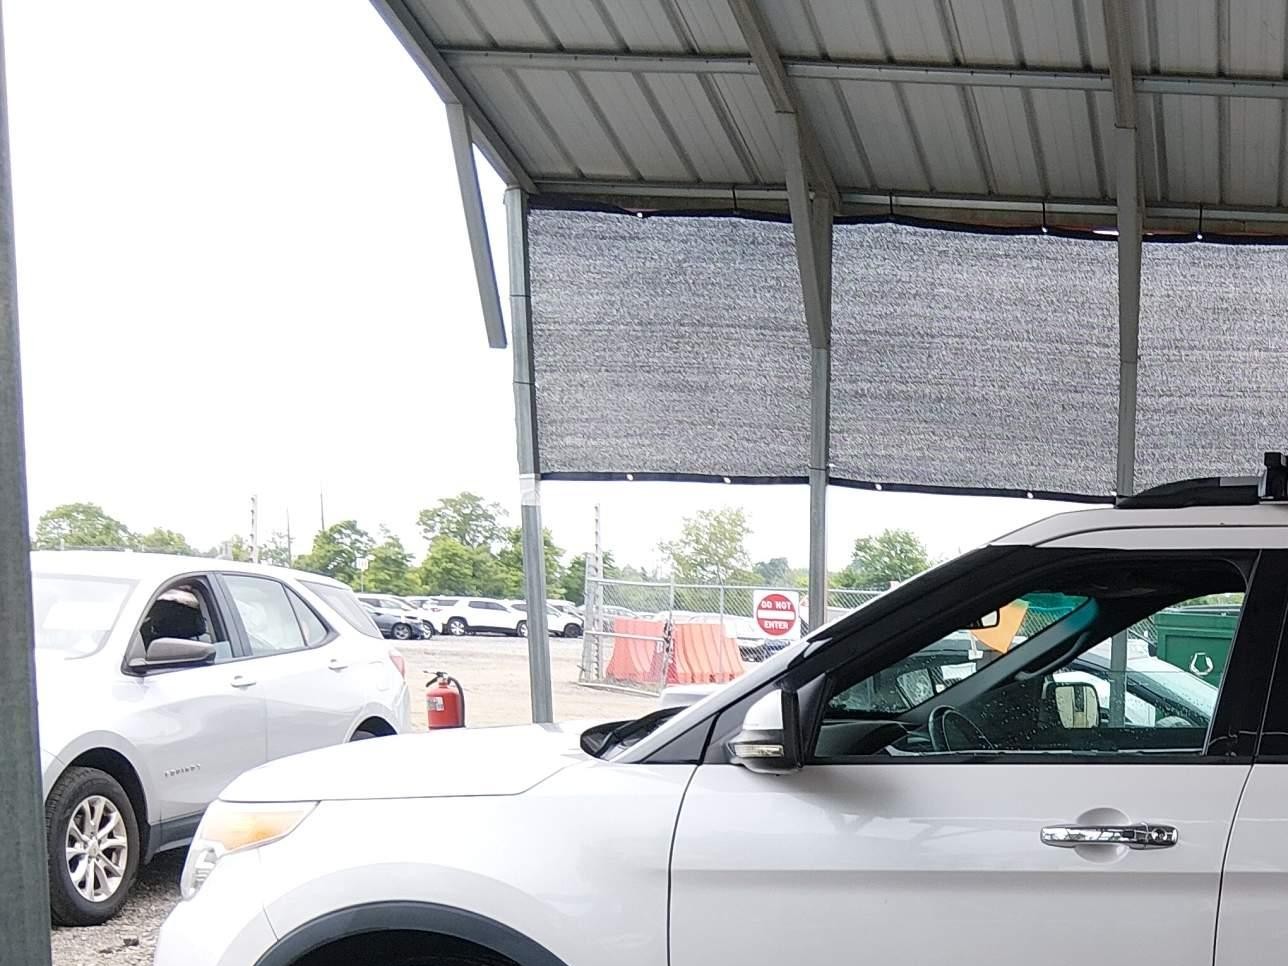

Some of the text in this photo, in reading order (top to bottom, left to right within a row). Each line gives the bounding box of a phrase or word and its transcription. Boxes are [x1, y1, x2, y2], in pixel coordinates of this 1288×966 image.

[761, 600, 792, 610] DO NOT
[764, 620, 789, 630] ENTER
